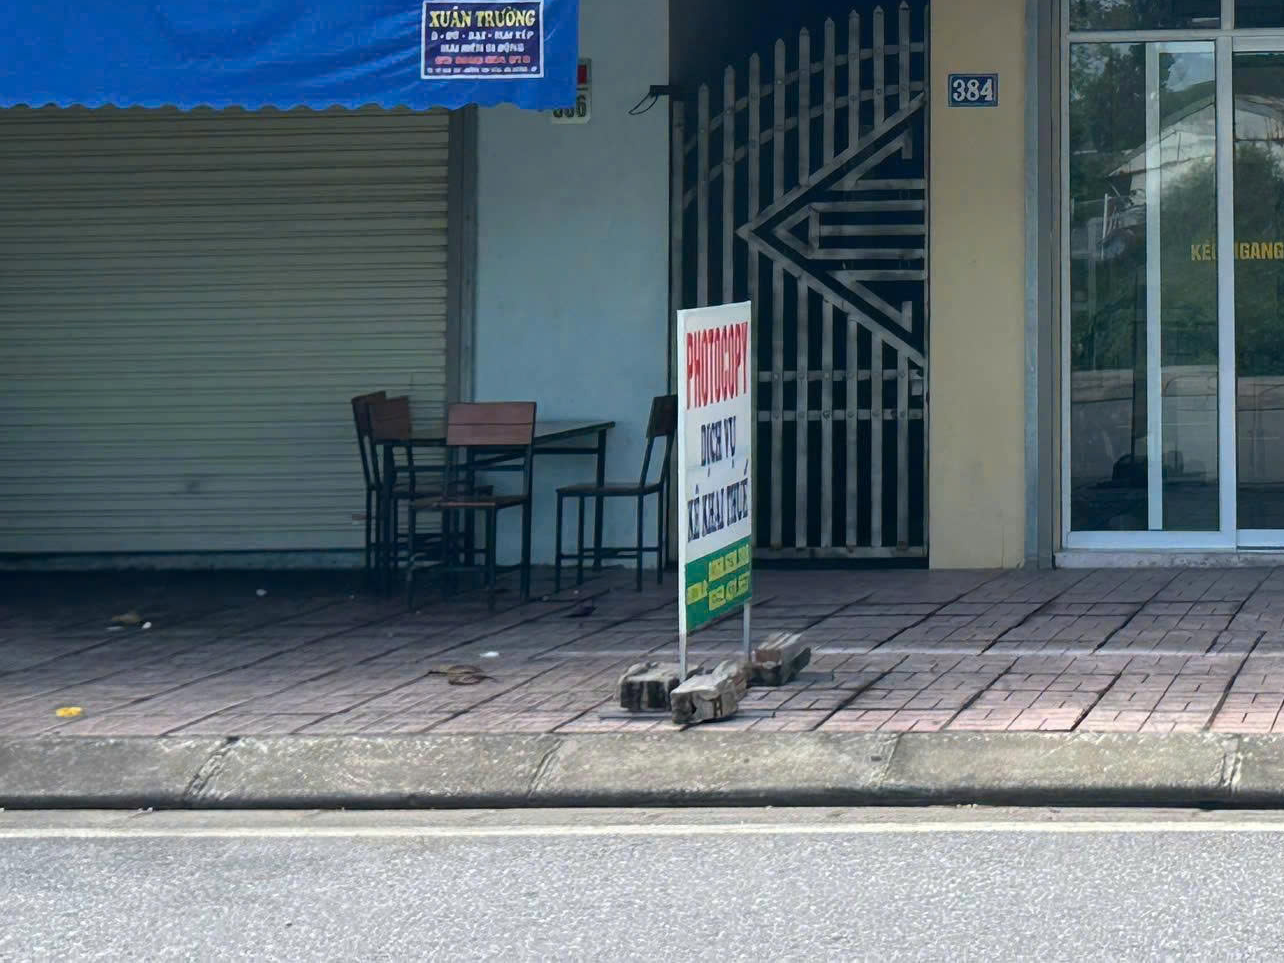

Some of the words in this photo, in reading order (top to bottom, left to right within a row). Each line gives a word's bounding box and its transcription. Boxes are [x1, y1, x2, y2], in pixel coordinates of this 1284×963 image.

[953, 79, 992, 101] 384
[1235, 242, 1284, 260] GANG
[686, 321, 748, 410] PHOTOCOPY
